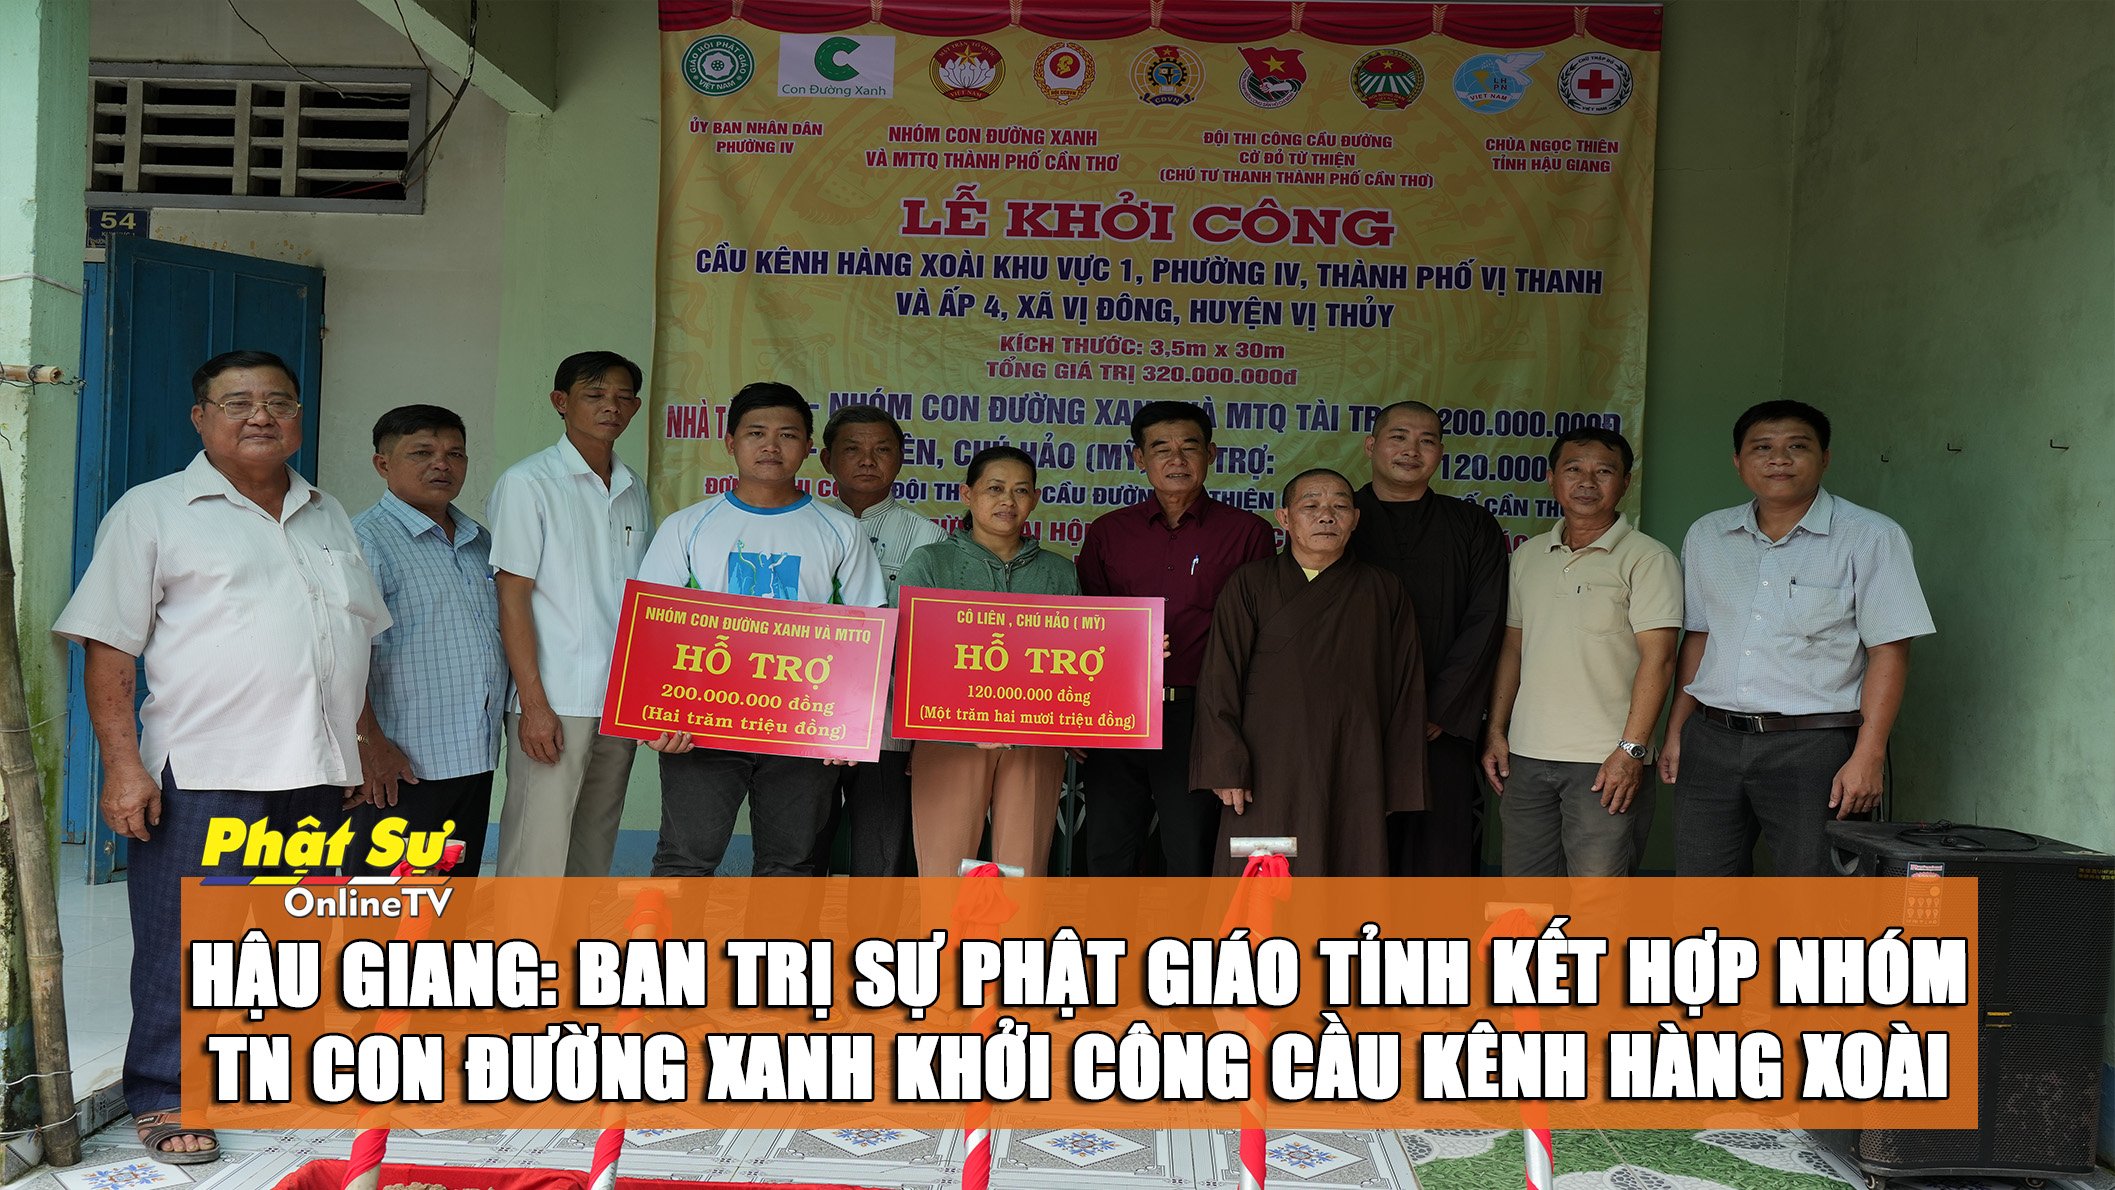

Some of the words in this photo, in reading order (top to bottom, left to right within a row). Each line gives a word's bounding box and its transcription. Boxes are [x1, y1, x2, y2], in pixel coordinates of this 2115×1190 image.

[716, 80, 737, 90] NAM
[782, 84, 806, 95] Con
[809, 84, 851, 97] Đường
[854, 85, 886, 96] Xanh
[690, 116, 709, 134] ỦY
[713, 122, 742, 135] BAN
[747, 120, 788, 135] NHÂN
[792, 121, 823, 136] DÂN
[888, 123, 940, 143] NHÓM
[946, 127, 981, 143] CON
[986, 126, 1045, 145] ĐƯỜNG
[1050, 130, 1098, 146] XANH
[1203, 130, 1229, 147] ĐỘI
[1234, 133, 1256, 146] THI
[1261, 131, 1301, 146] CÔNG
[1307, 130, 1337, 147] CẦU
[1341, 132, 1393, 148] ĐƯỜNG
[716, 138, 775, 154] PHƯỜNG
[780, 142, 795, 154] IV
[1485, 136, 1526, 152] CHÙA
[1530, 139, 1572, 154] NGỌC
[1577, 138, 1619, 154] THIÊN
[866, 147, 888, 167] VÀ
[892, 152, 938, 169] MTTQ
[944, 149, 999, 169] THÀNH
[1005, 149, 1041, 170] PHỐ
[1045, 151, 1080, 171] CẦN
[1086, 154, 1120, 172] THƠ
[1239, 150, 1260, 164] CỜ
[1264, 148, 1284, 164] ĐỎ
[1288, 151, 1309, 165] TỪ
[1312, 151, 1355, 169] THIỆN
[1492, 156, 1526, 170] TỈNH
[1532, 157, 1562, 173] HẬU
[1566, 159, 1611, 173] GIANG
[1160, 168, 1195, 182] (CHÚ
[1200, 170, 1218, 182] TƯ
[1223, 170, 1271, 183] THANH
[1277, 170, 1324, 184] THÀNH
[1330, 170, 1361, 185] PHỐ
[1364, 170, 1395, 186] CẦN
[1400, 174, 1434, 188] THƠ)
[100, 211, 137, 230] 54
[902, 184, 990, 237] LỄ
[1005, 191, 1174, 242] KHỞI
[1193, 198, 1396, 246] CÔNG
[696, 243, 747, 275] CẦU
[755, 246, 828, 276] KÊNH
[837, 245, 912, 277] HÀNG
[921, 247, 984, 279] XOÀI
[993, 256, 1048, 280] KHU
[1057, 256, 1110, 287] VỰC
[1120, 258, 1143, 285] 1,
[1152, 254, 1265, 285] PHƯỜNG
[1275, 262, 1309, 290] IV,
[1317, 257, 1408, 289] THÀNH
[1416, 258, 1476, 291] PHỐ
[1481, 267, 1507, 297] VỊ
[1515, 268, 1604, 294] THANH
[896, 290, 931, 317] VÀ
[938, 286, 975, 318] ẤP
[984, 294, 1008, 322] 4,
[1017, 289, 1054, 320] XÃ
[1063, 295, 1088, 327] VỊ
[1097, 292, 1180, 326] ĐÔNG,
[1190, 297, 1282, 331] HUYỆN
[1291, 303, 1316, 333] VỊ
[1325, 295, 1395, 329] THỦY
[1000, 333, 1054, 354] KÍCH
[1061, 334, 1144, 356] THƯỚC:
[1150, 340, 1207, 359] 3,5m
[1213, 345, 1229, 358] x
[1235, 341, 1286, 359] 30m
[986, 358, 1047, 380] TỔNG
[1055, 358, 1093, 380] GIÁ
[1100, 364, 1135, 385] TRỊ
[1143, 366, 1298, 386] 320.000.000đ
[666, 400, 710, 439] NHÀ
[921, 394, 980, 421] CON
[988, 393, 1085, 425] ĐƯỜNG
[1226, 401, 1287, 433] MTQ
[1296, 399, 1338, 431] TÀI
[1216, 444, 1274, 480] TRỢ:
[892, 478, 927, 503] ĐỘI
[1042, 482, 1086, 504] CẦU
[1092, 484, 1153, 506] ĐƯỜN
[645, 606, 687, 625] NHÓM
[690, 613, 719, 629] CON
[722, 615, 769, 635] ĐƯỜNG
[773, 623, 810, 639] XANH
[814, 623, 831, 640] VÀ
[835, 629, 872, 645] MTTQ
[957, 610, 974, 624] CÔ
[977, 610, 1005, 626] LIÊN
[1016, 611, 1041, 628] CHÚ
[1045, 611, 1070, 629] HẢO
[673, 634, 732, 675] HỖ
[748, 652, 833, 690] TRỢ
[954, 632, 1009, 672] HỖ
[1024, 646, 1106, 682] TRỢ
[661, 684, 782, 709] 200.000.000
[788, 690, 835, 717] đồng
[967, 685, 1053, 702] 120.000.000
[1057, 686, 1091, 706] đồng
[641, 704, 680, 723] (Hai
[687, 710, 733, 729] trăm
[740, 715, 788, 735] triệu
[794, 718, 847, 742] đồng)
[920, 704, 951, 721] (Một
[956, 707, 989, 722] trăm
[994, 709, 1016, 723] hai
[1020, 712, 1054, 726] mươi
[1059, 711, 1093, 728] triệu
[1098, 710, 1136, 731] đồng)
